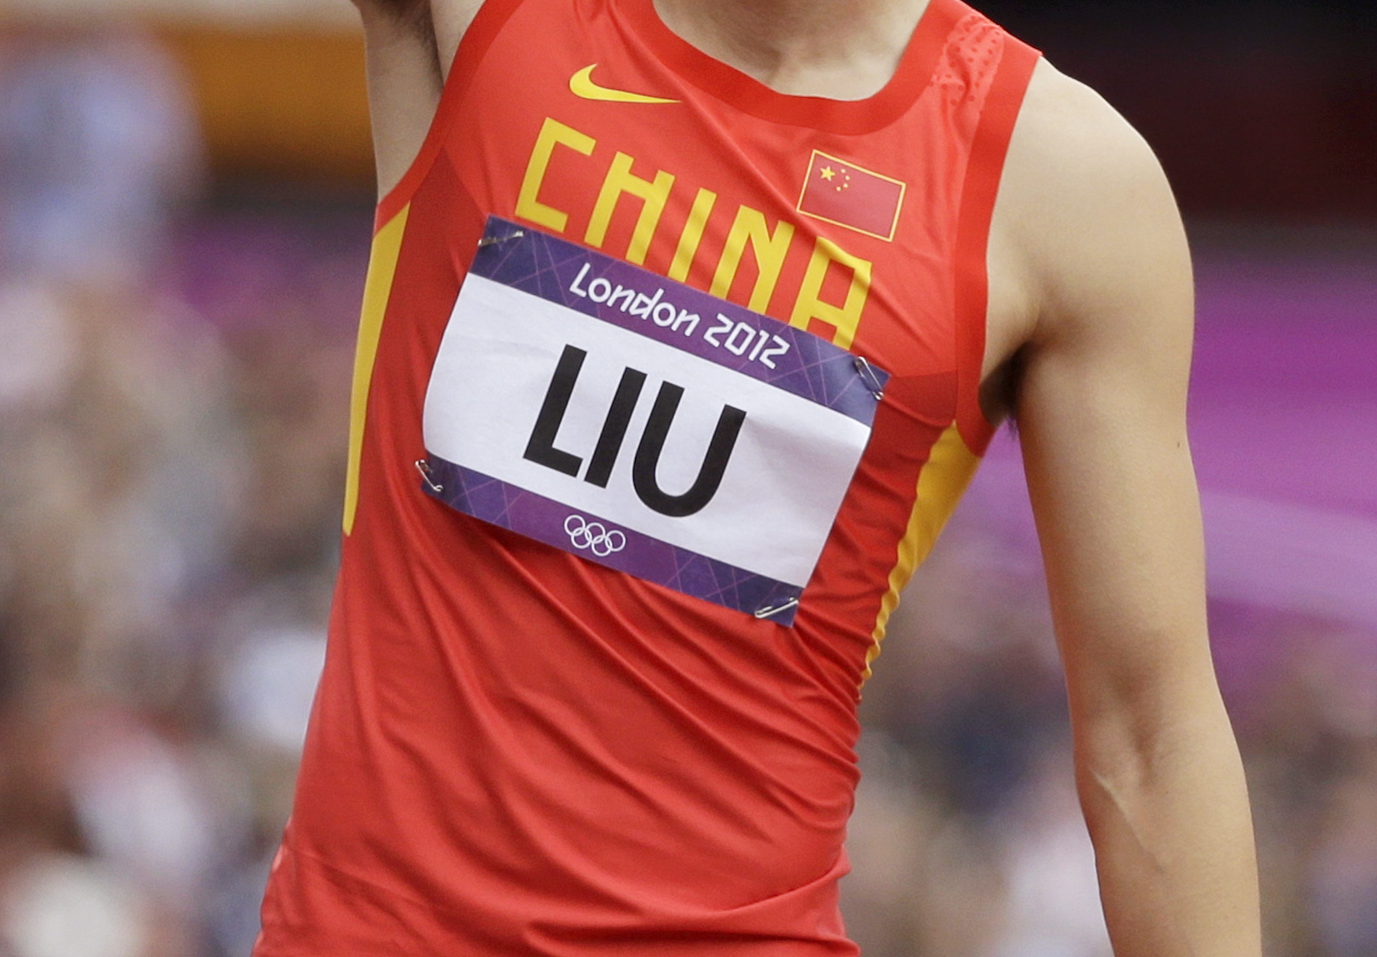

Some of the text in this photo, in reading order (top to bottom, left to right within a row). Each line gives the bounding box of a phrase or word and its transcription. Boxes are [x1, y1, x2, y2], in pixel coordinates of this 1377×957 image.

[515, 117, 872, 350] CHINA
[570, 262, 790, 369] London 2012
[523, 344, 747, 518] LIU
